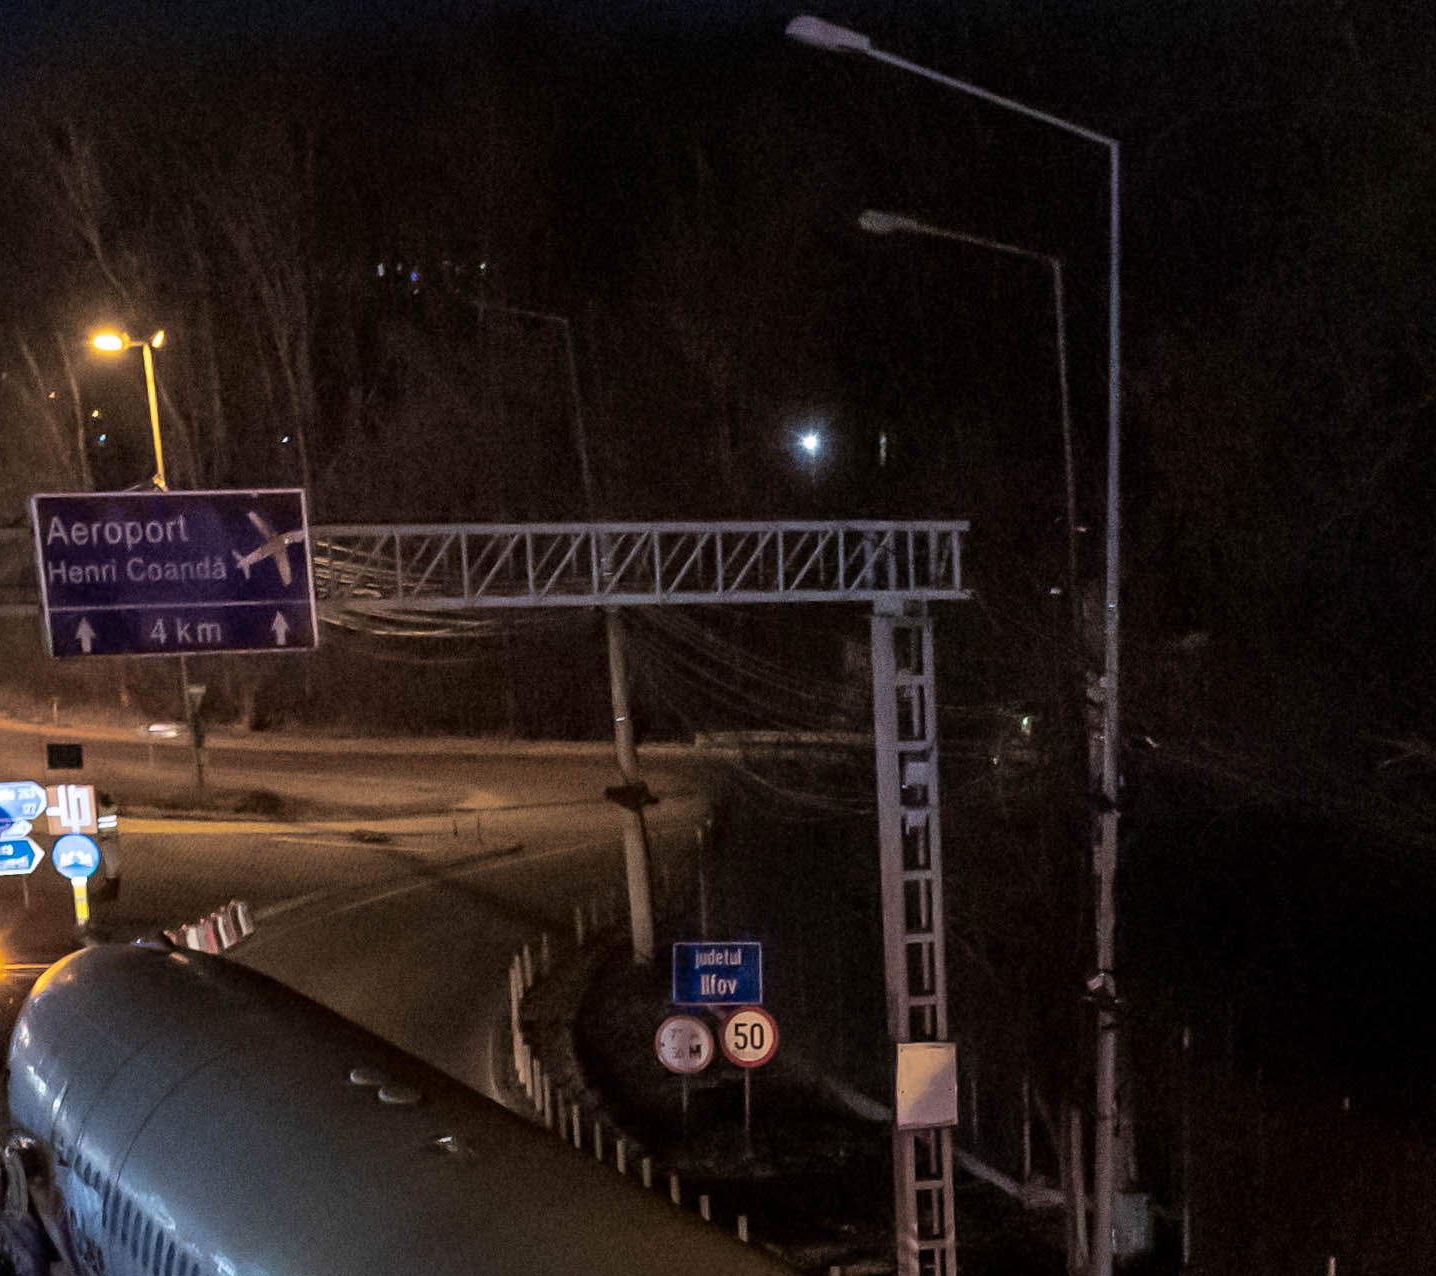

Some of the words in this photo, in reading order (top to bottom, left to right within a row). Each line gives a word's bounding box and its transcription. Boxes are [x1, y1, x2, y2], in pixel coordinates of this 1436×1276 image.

[46, 514, 189, 550] Aeroport
[47, 559, 117, 584] Henri
[150, 617, 167, 645] 4
[176, 617, 223, 644] km
[700, 973, 737, 996] Ilfov
[734, 1022, 765, 1051] 50
